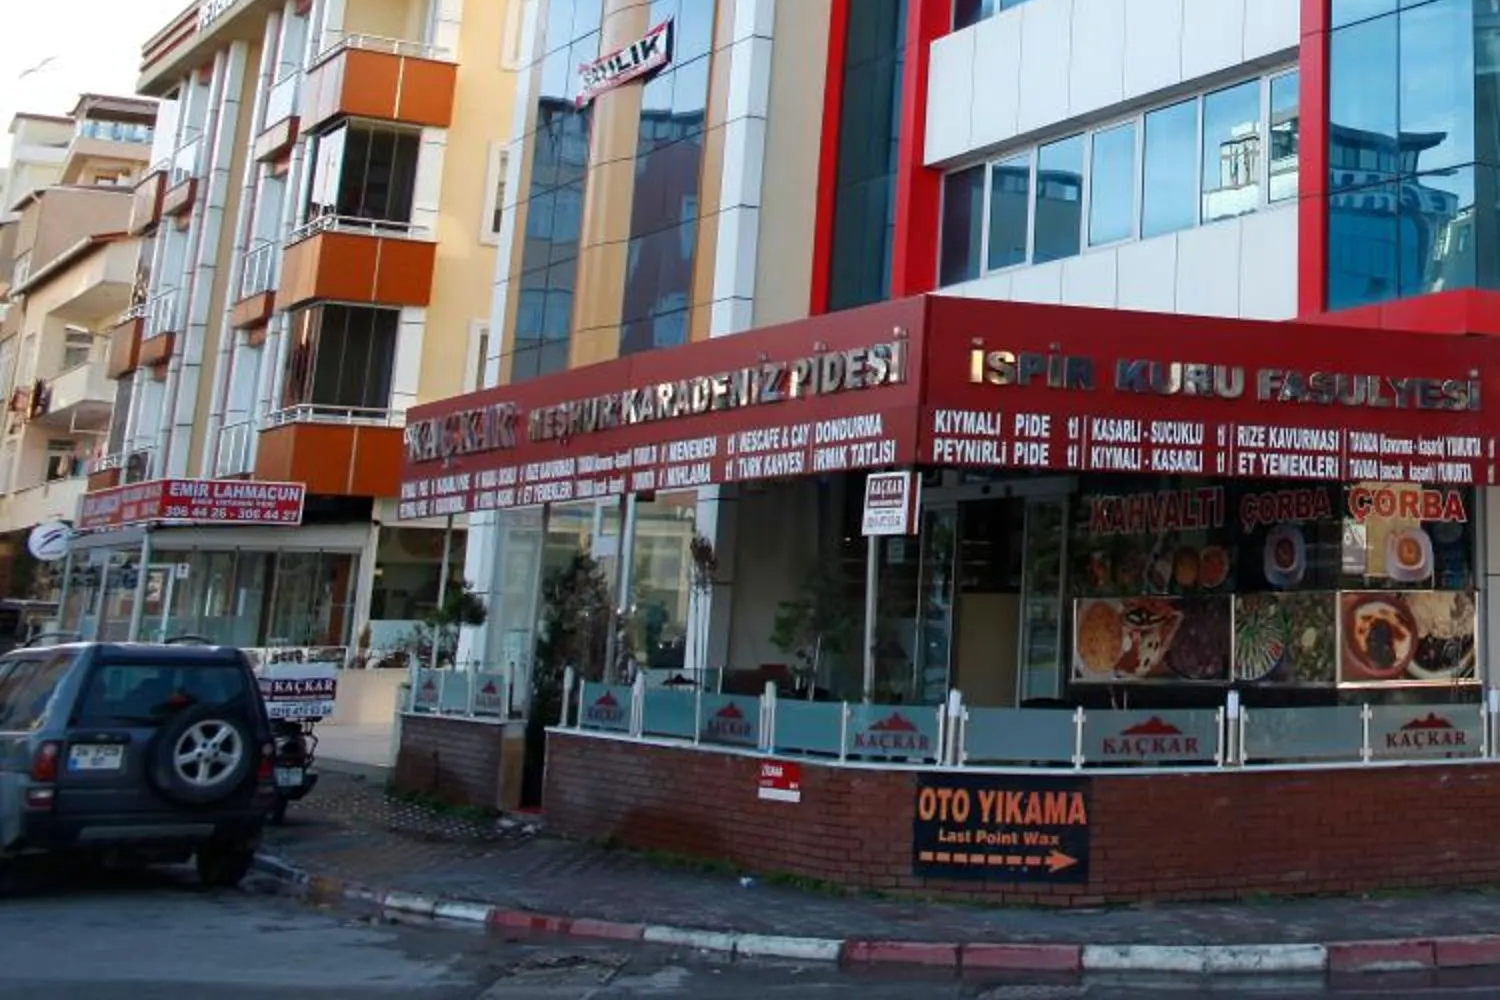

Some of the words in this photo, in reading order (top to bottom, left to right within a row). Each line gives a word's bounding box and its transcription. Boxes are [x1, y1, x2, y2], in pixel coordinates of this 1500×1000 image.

[621, 351, 788, 426] KARADENİZ
[789, 326, 909, 400] PİDESİ
[969, 337, 1097, 391] İSPİR
[1115, 357, 1245, 398] KURU
[1256, 368, 1483, 412] FASULYESİ
[815, 413, 883, 444] DONDURMA
[934, 409, 1001, 437] KIYMALI
[1092, 418, 1141, 444] KAŞARLI
[1151, 421, 1205, 445] SUCUKLU
[933, 438, 1007, 465] PEYNİRLİ
[1269, 426, 1340, 451] KAVURMASI
[851, 439, 897, 467] TATLISI
[1091, 446, 1141, 470] KIYMALI
[1238, 452, 1257, 475] ET
[169, 480, 209, 497] EMİR
[213, 483, 299, 501] LAHMACUN
[1088, 486, 1226, 535] KAHVALTI
[1239, 487, 1333, 533] ÇORBA
[1348, 486, 1468, 525] ÇORBA
[274, 680, 334, 695] KAÇKAR
[854, 733, 930, 753] KAÇKAR
[1102, 737, 1199, 757] KAÇKAR
[1385, 730, 1468, 750] KAÇKAR
[918, 786, 971, 823] OTO
[977, 788, 1087, 826] YIKAMA
[938, 828, 971, 844] Last
[975, 829, 1018, 845] Point
[1022, 830, 1061, 846] Wax
